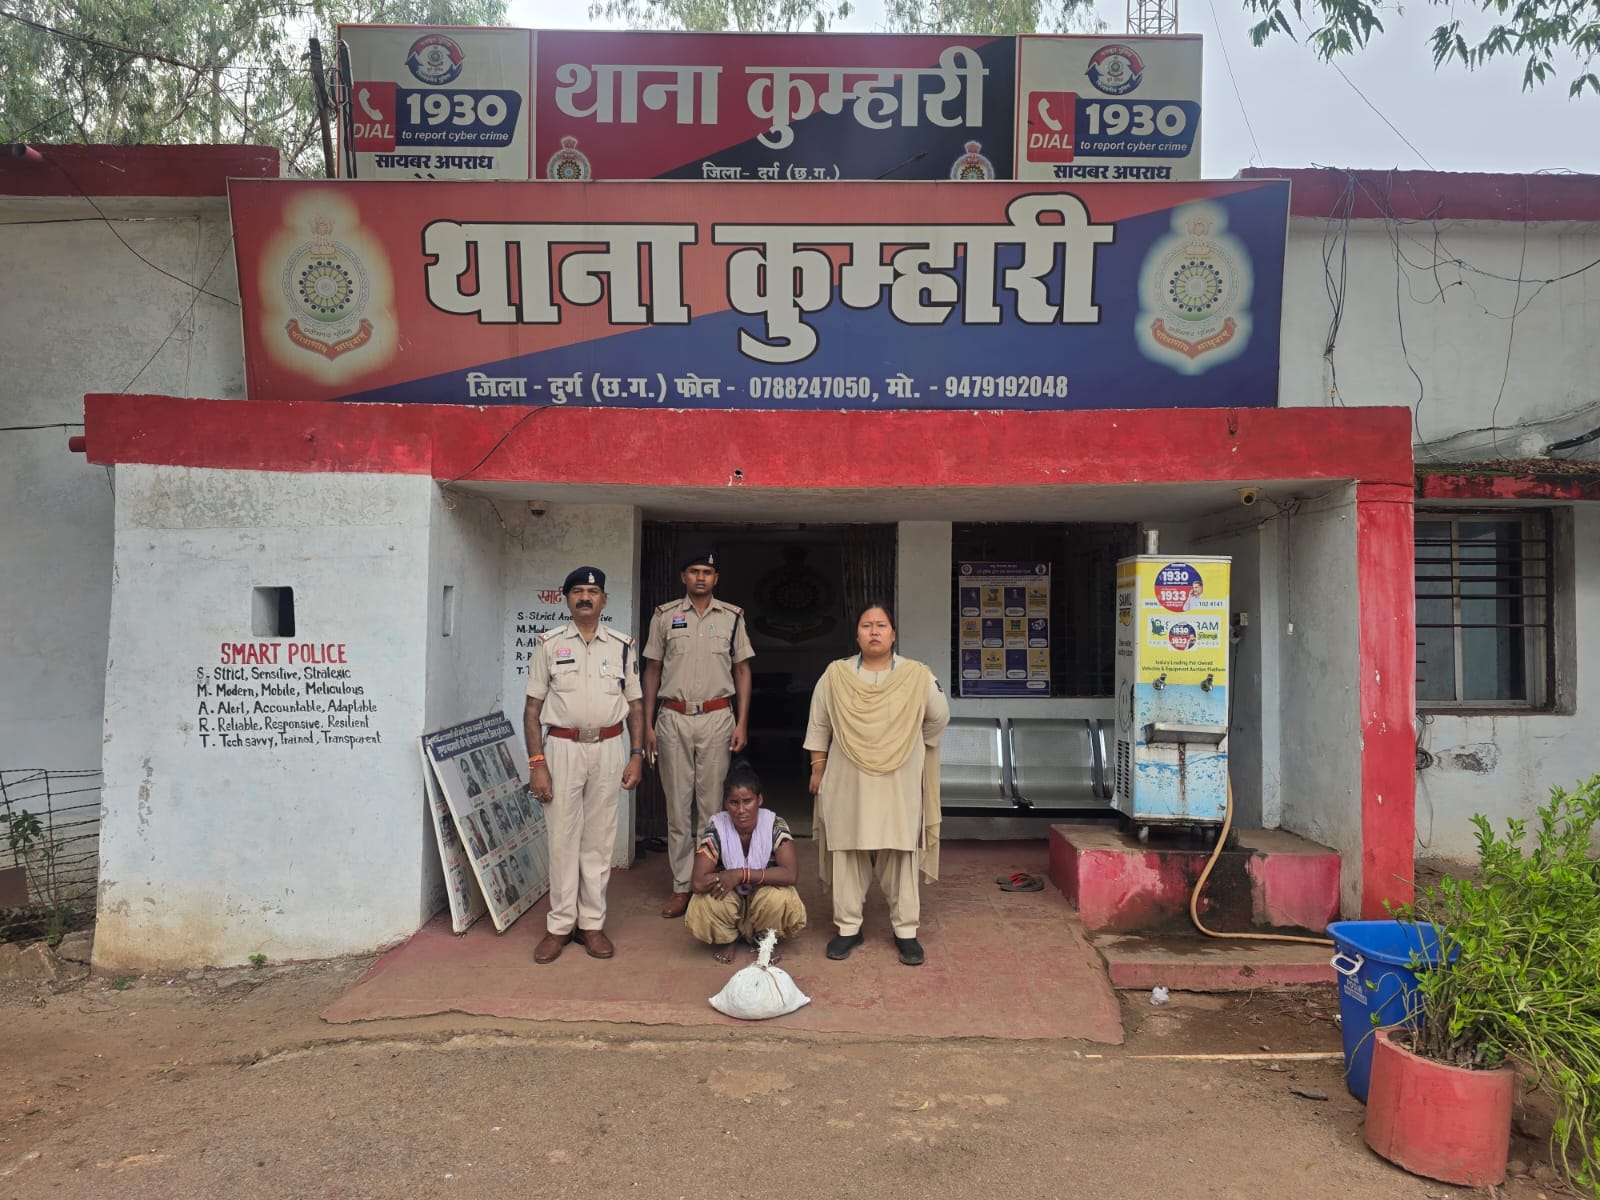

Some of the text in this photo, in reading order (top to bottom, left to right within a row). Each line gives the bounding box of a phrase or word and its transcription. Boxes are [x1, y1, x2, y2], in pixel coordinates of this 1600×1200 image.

[554, 46, 990, 150] थाना कुम्हारी
[407, 93, 507, 127] 1930
[1086, 103, 1186, 136] 1930
[353, 123, 394, 139] DIAL
[402, 130, 509, 142] to report cyber crime
[1029, 133, 1073, 149] DIAL
[1080, 140, 1188, 152] to report cyber crime
[375, 154, 495, 169] सायबर अपराध
[1053, 164, 1172, 180] सायबर अपराध
[422, 191, 1116, 365] थाना कुम्हारी
[466, 372, 527, 397] जिला
[548, 372, 583, 404] दुर्ग
[591, 373, 667, 403] (छ.ग.)
[674, 372, 721, 398] फोन
[749, 376, 879, 402] 0788247050,
[885, 373, 921, 398] मो.
[945, 375, 1068, 398] 9479192048
[1161, 570, 1189, 582] 1930
[1160, 590, 1187, 601] 1933
[221, 643, 347, 665] SMART POLICE
[197, 666, 210, 680] S.
[214, 666, 248, 681] Strict,
[251, 666, 301, 681] Sensitive,
[197, 681, 364, 698] M. Modern, Mobile, Meticulous
[198, 699, 378, 715] A. Alert, Accountable, Adaptable
[199, 714, 369, 734] R. Reliable, Responsive, Resilient
[199, 733, 216, 748] T.
